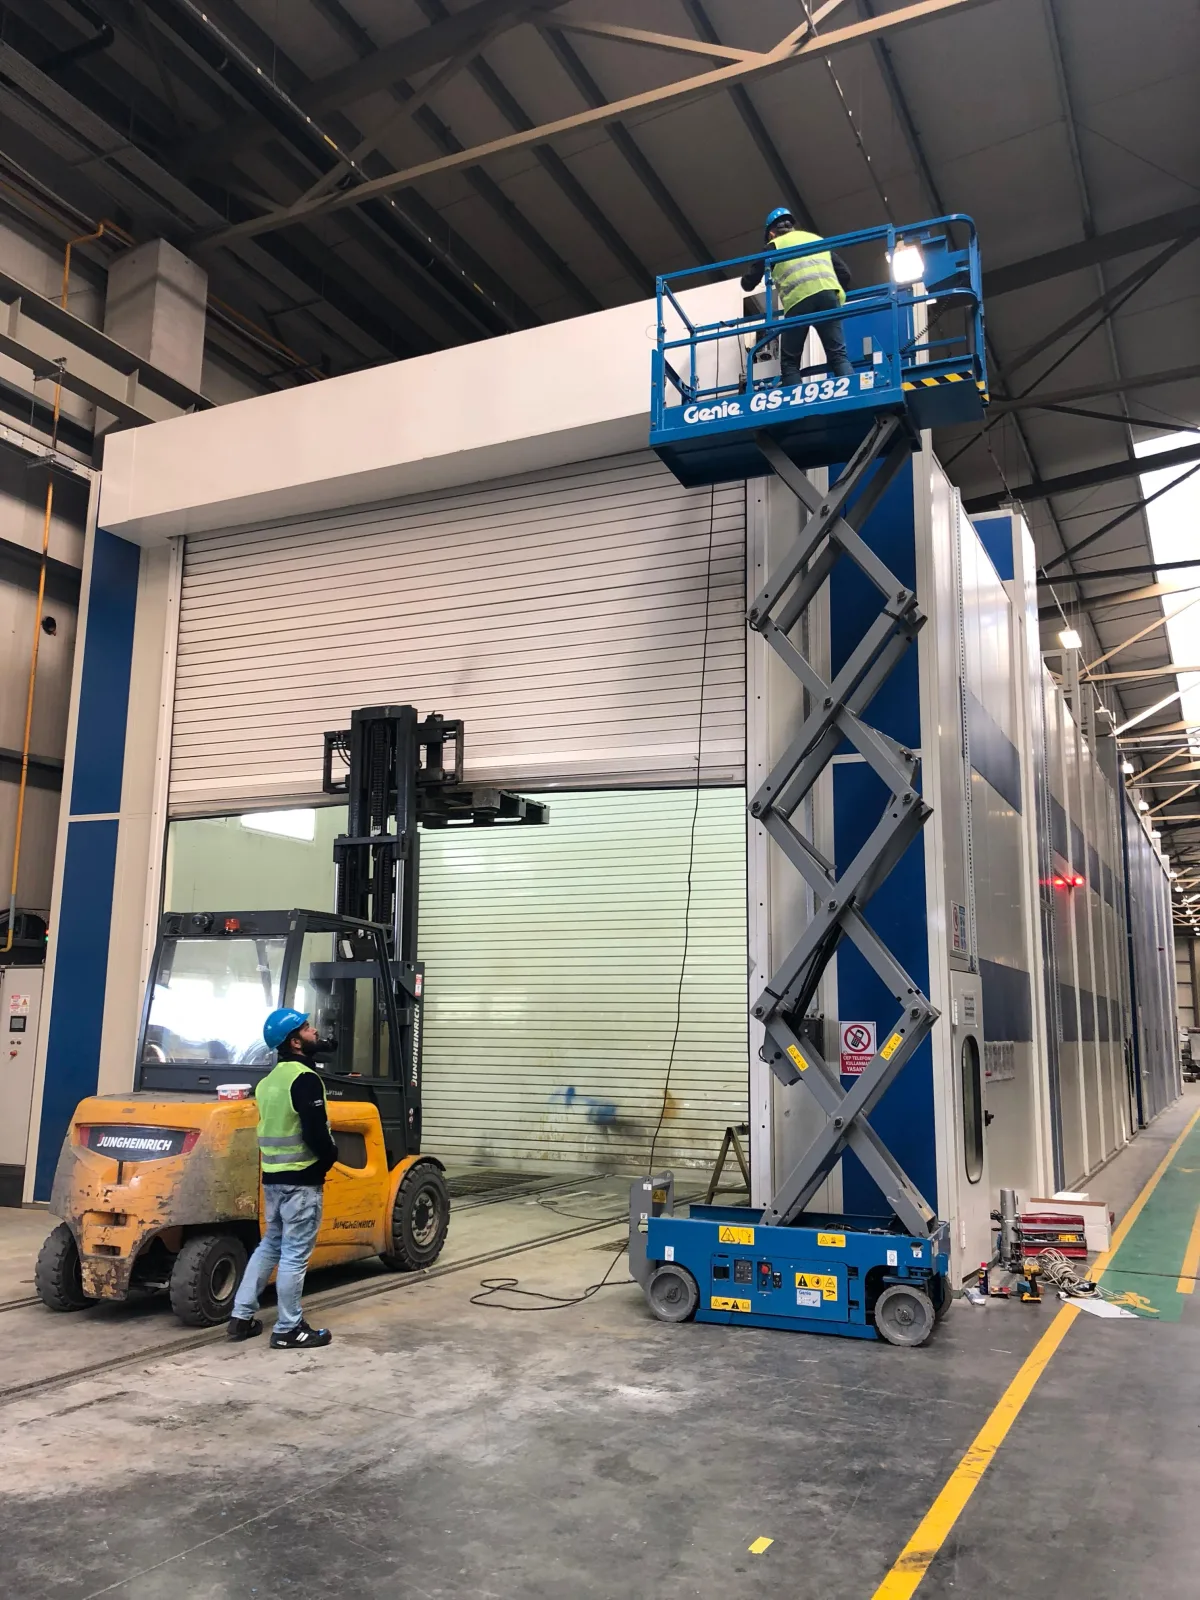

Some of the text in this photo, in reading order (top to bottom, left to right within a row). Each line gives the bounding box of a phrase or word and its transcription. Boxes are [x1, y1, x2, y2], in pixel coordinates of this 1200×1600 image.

[684, 378, 850, 424] Genie GS-1932
[411, 1004, 420, 1087] JUNGHEINRICH
[97, 1134, 172, 1151] JUNGHEINRICH
